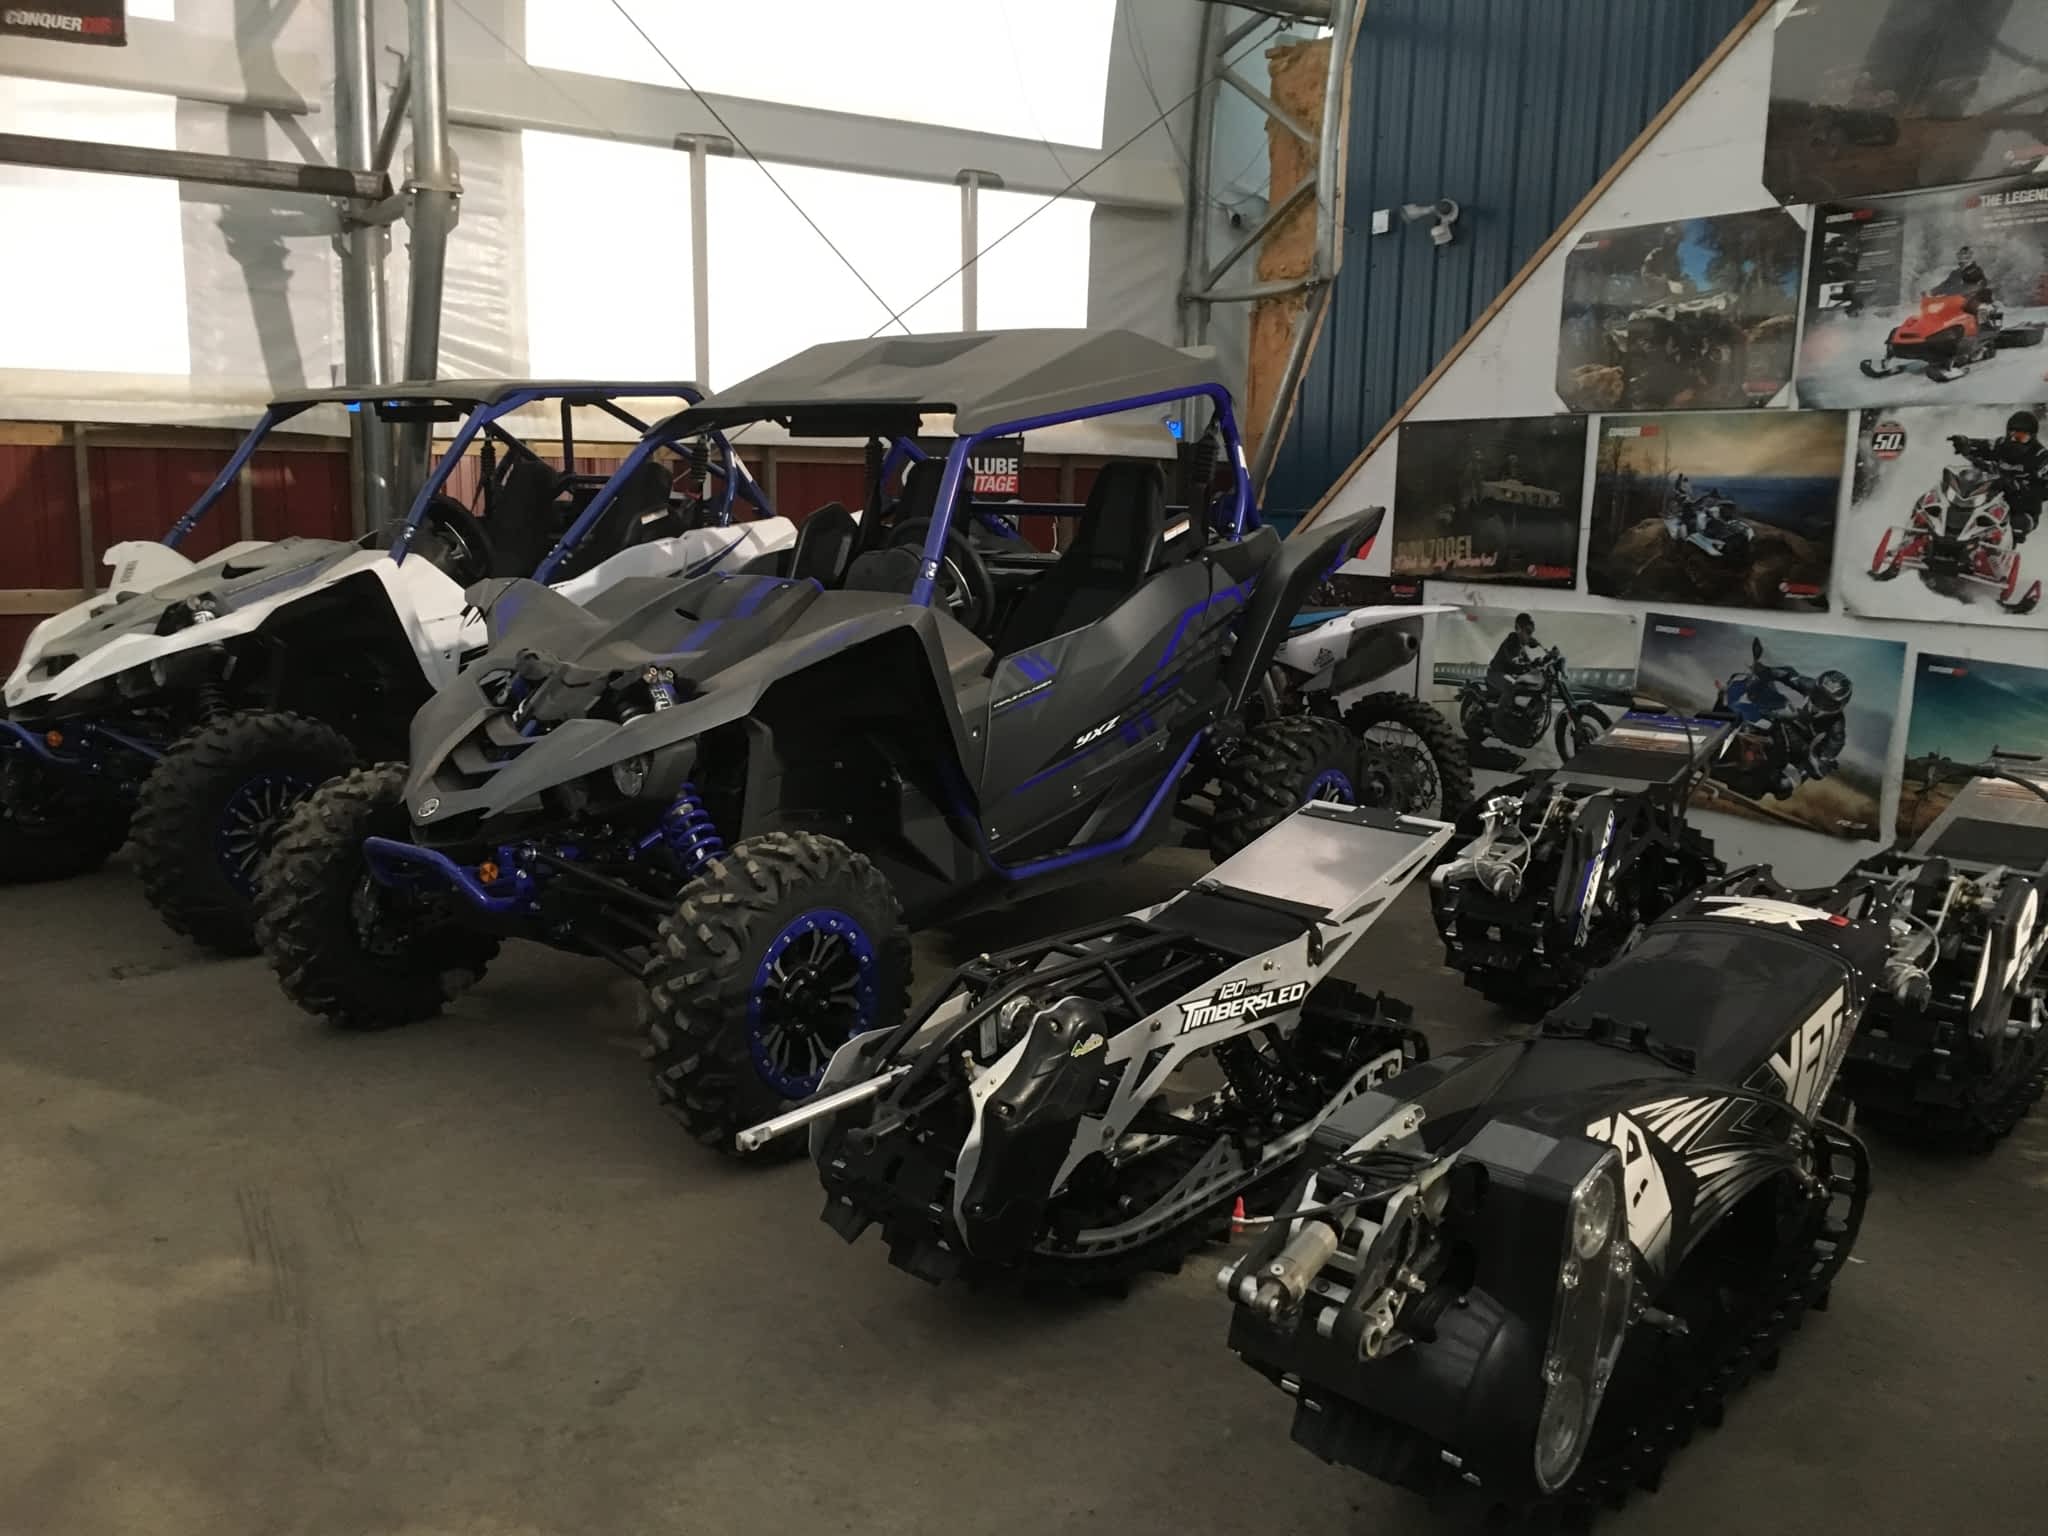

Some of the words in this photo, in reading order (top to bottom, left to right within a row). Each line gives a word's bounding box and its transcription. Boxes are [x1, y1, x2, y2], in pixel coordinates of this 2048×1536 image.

[5, 8, 82, 32] CONQUER
[1979, 193, 2003, 207] THE
[1873, 433, 1902, 450] 50
